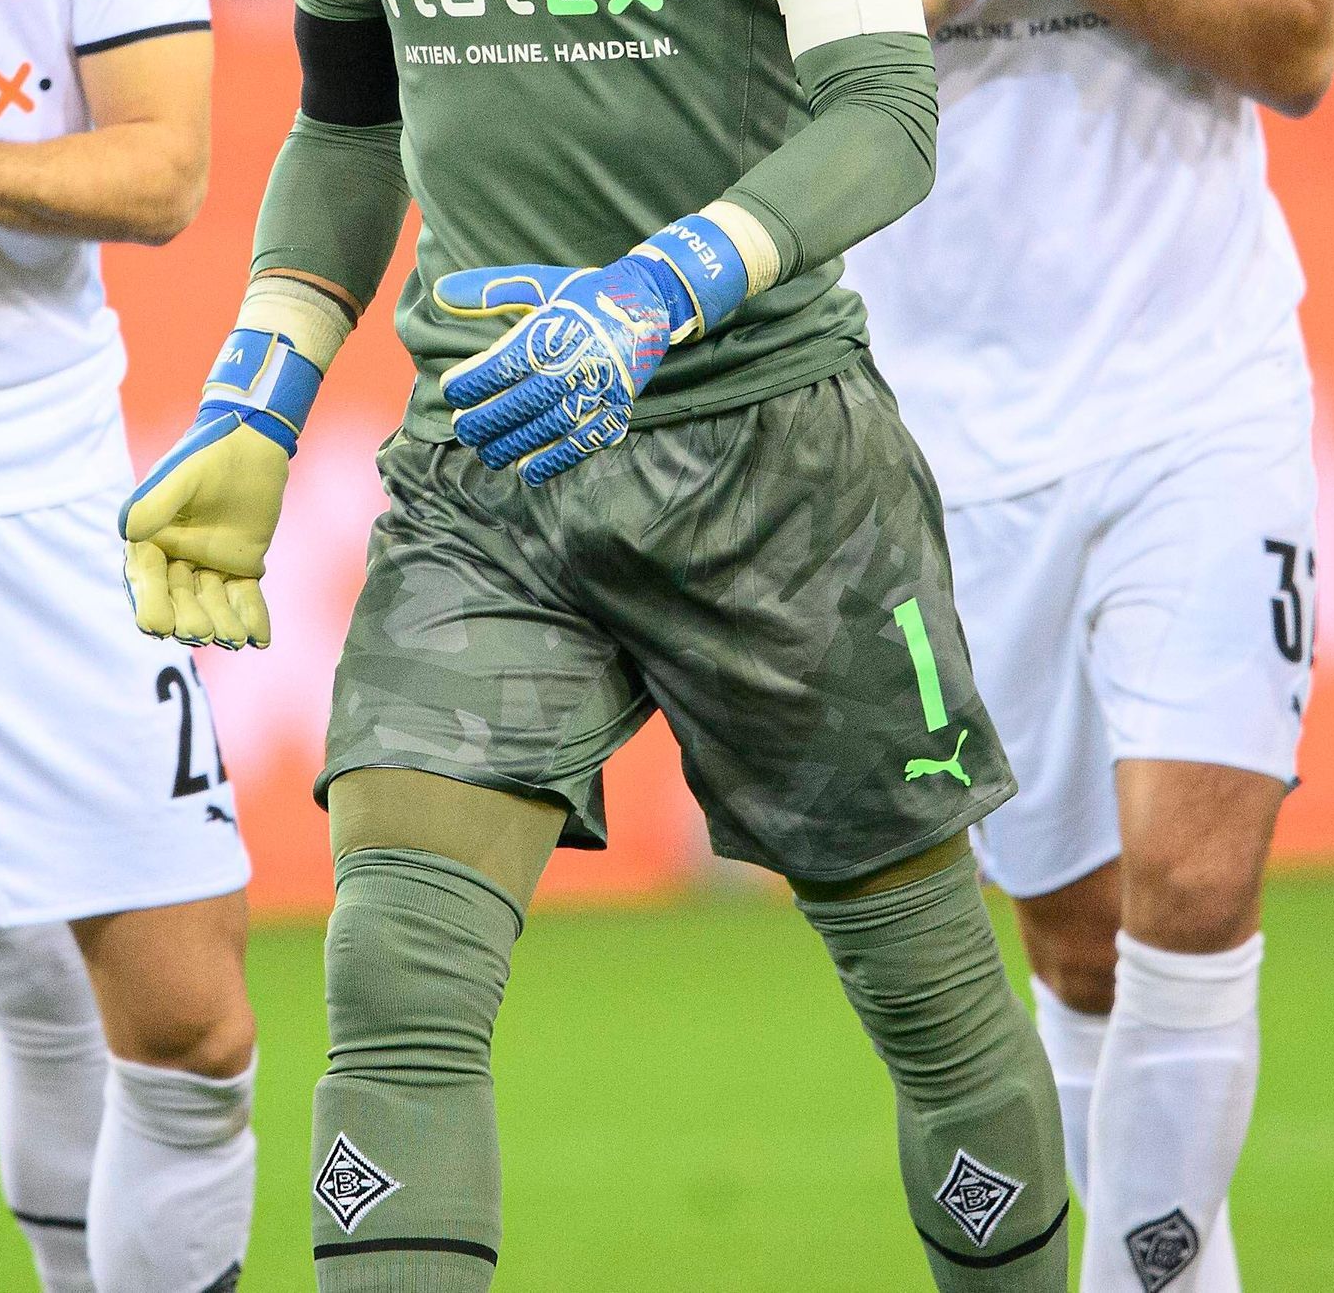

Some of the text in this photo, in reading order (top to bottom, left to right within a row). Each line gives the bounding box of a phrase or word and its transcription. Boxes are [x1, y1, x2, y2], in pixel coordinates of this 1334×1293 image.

[405, 37, 679, 65] AKTIEN. ONLINE. HANDELN.
[893, 597, 948, 733] 1
[1265, 539, 1316, 670] 3
[156, 655, 228, 794] 2
